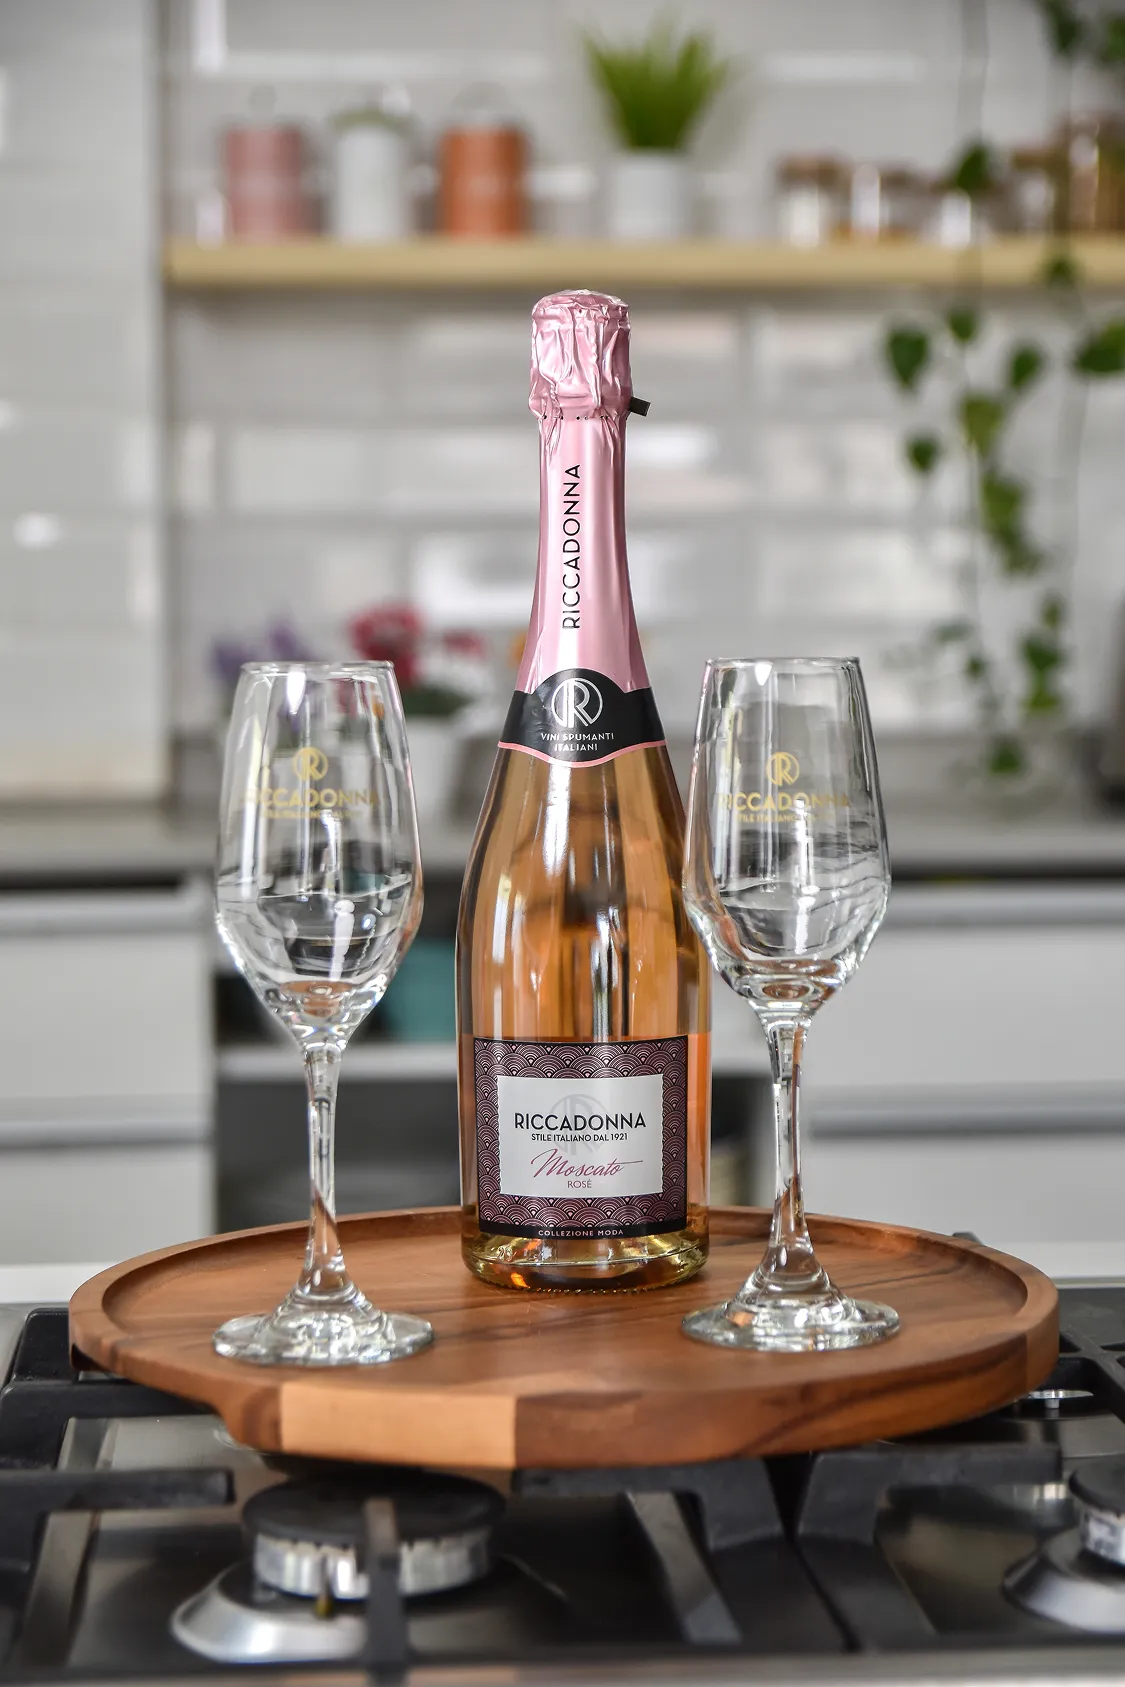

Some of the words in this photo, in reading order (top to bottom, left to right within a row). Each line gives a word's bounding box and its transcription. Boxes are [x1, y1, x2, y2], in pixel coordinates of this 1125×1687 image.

[562, 464, 581, 629] RICCADONNA
[541, 732, 560, 741] VINI
[563, 732, 615, 741] SPUMANTI
[554, 743, 598, 752] ITALIANI
[514, 1112, 646, 1131] RICCADONNA
[531, 1133, 552, 1142] STILE
[553, 1133, 592, 1142] ITALIANO
[593, 1133, 609, 1142] DAL
[610, 1132, 628, 1141] 1921
[530, 1148, 643, 1178] Moscato
[567, 1179, 592, 1189] ROSÉ
[538, 1229, 594, 1237] COLLEZIONE
[597, 1229, 624, 1237] MODA
